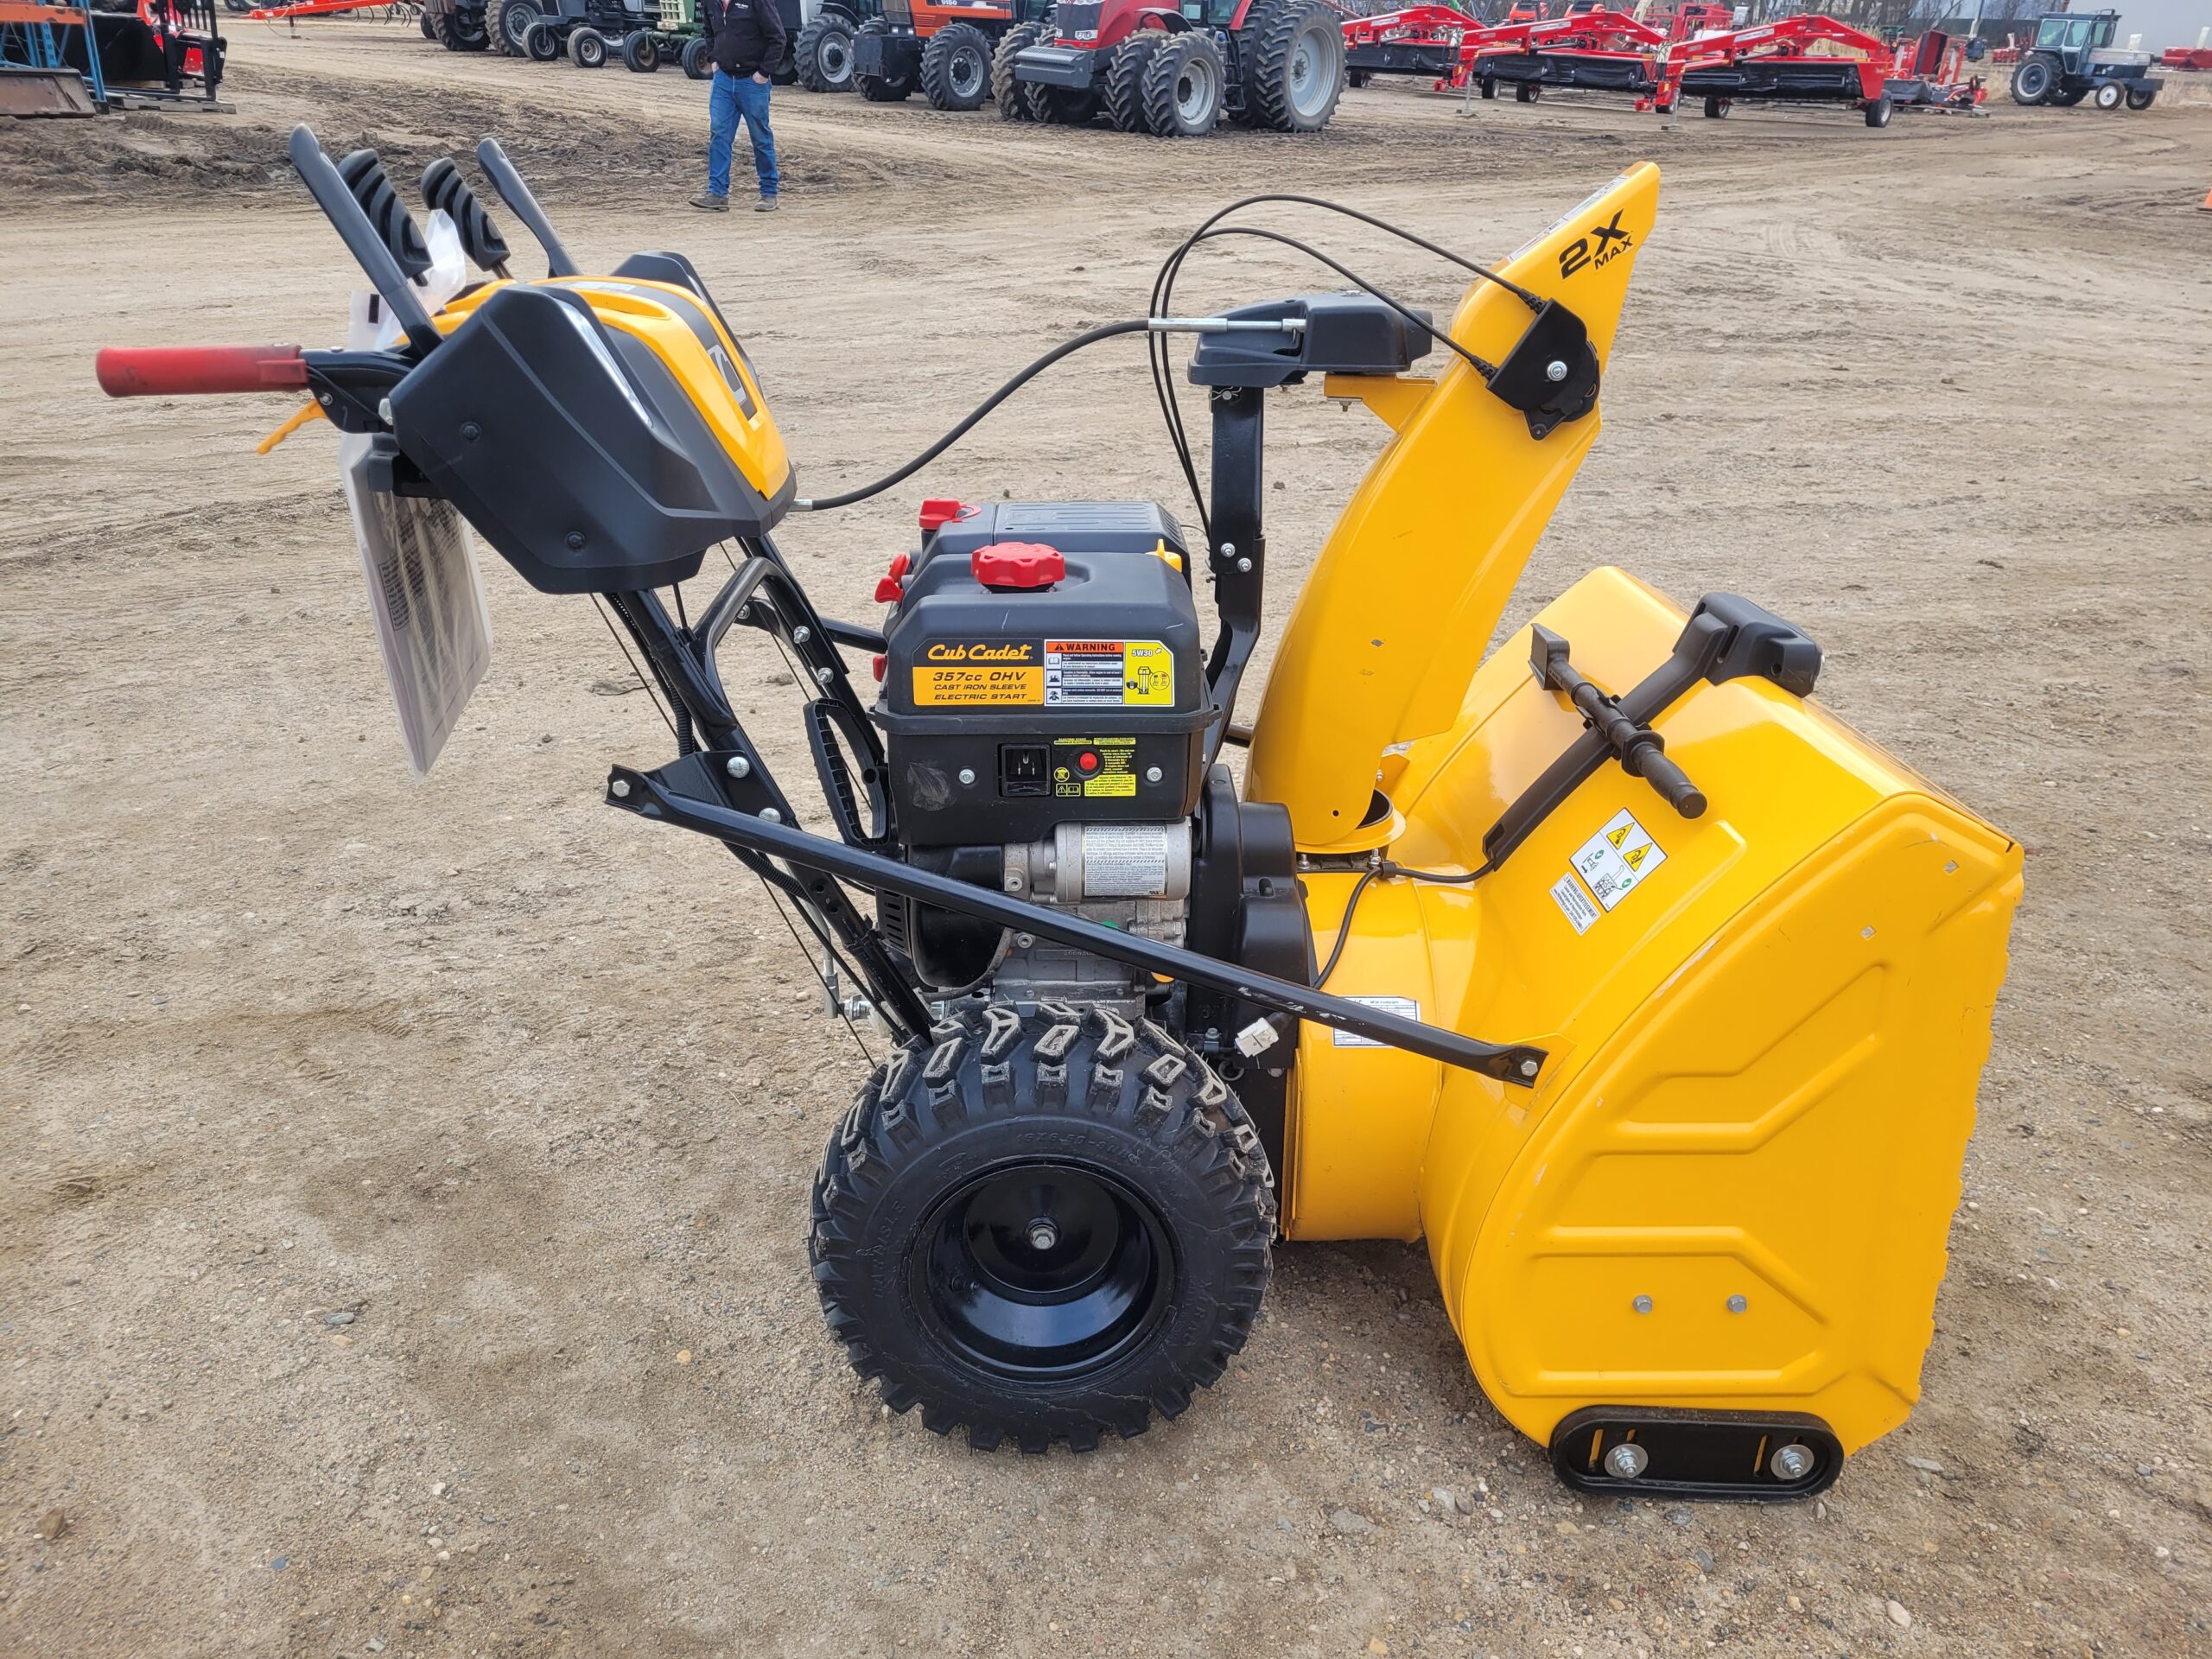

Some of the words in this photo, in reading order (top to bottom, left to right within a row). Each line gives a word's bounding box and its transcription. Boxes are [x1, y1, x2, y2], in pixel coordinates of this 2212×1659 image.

[1559, 208, 1630, 280] 2X
[1594, 235, 1633, 270] MAX
[927, 644, 967, 660] Cub
[968, 644, 1033, 660] Cadet
[1065, 643, 1116, 652] WARNING
[932, 671, 982, 682] 357cc
[989, 671, 1027, 682] OHV
